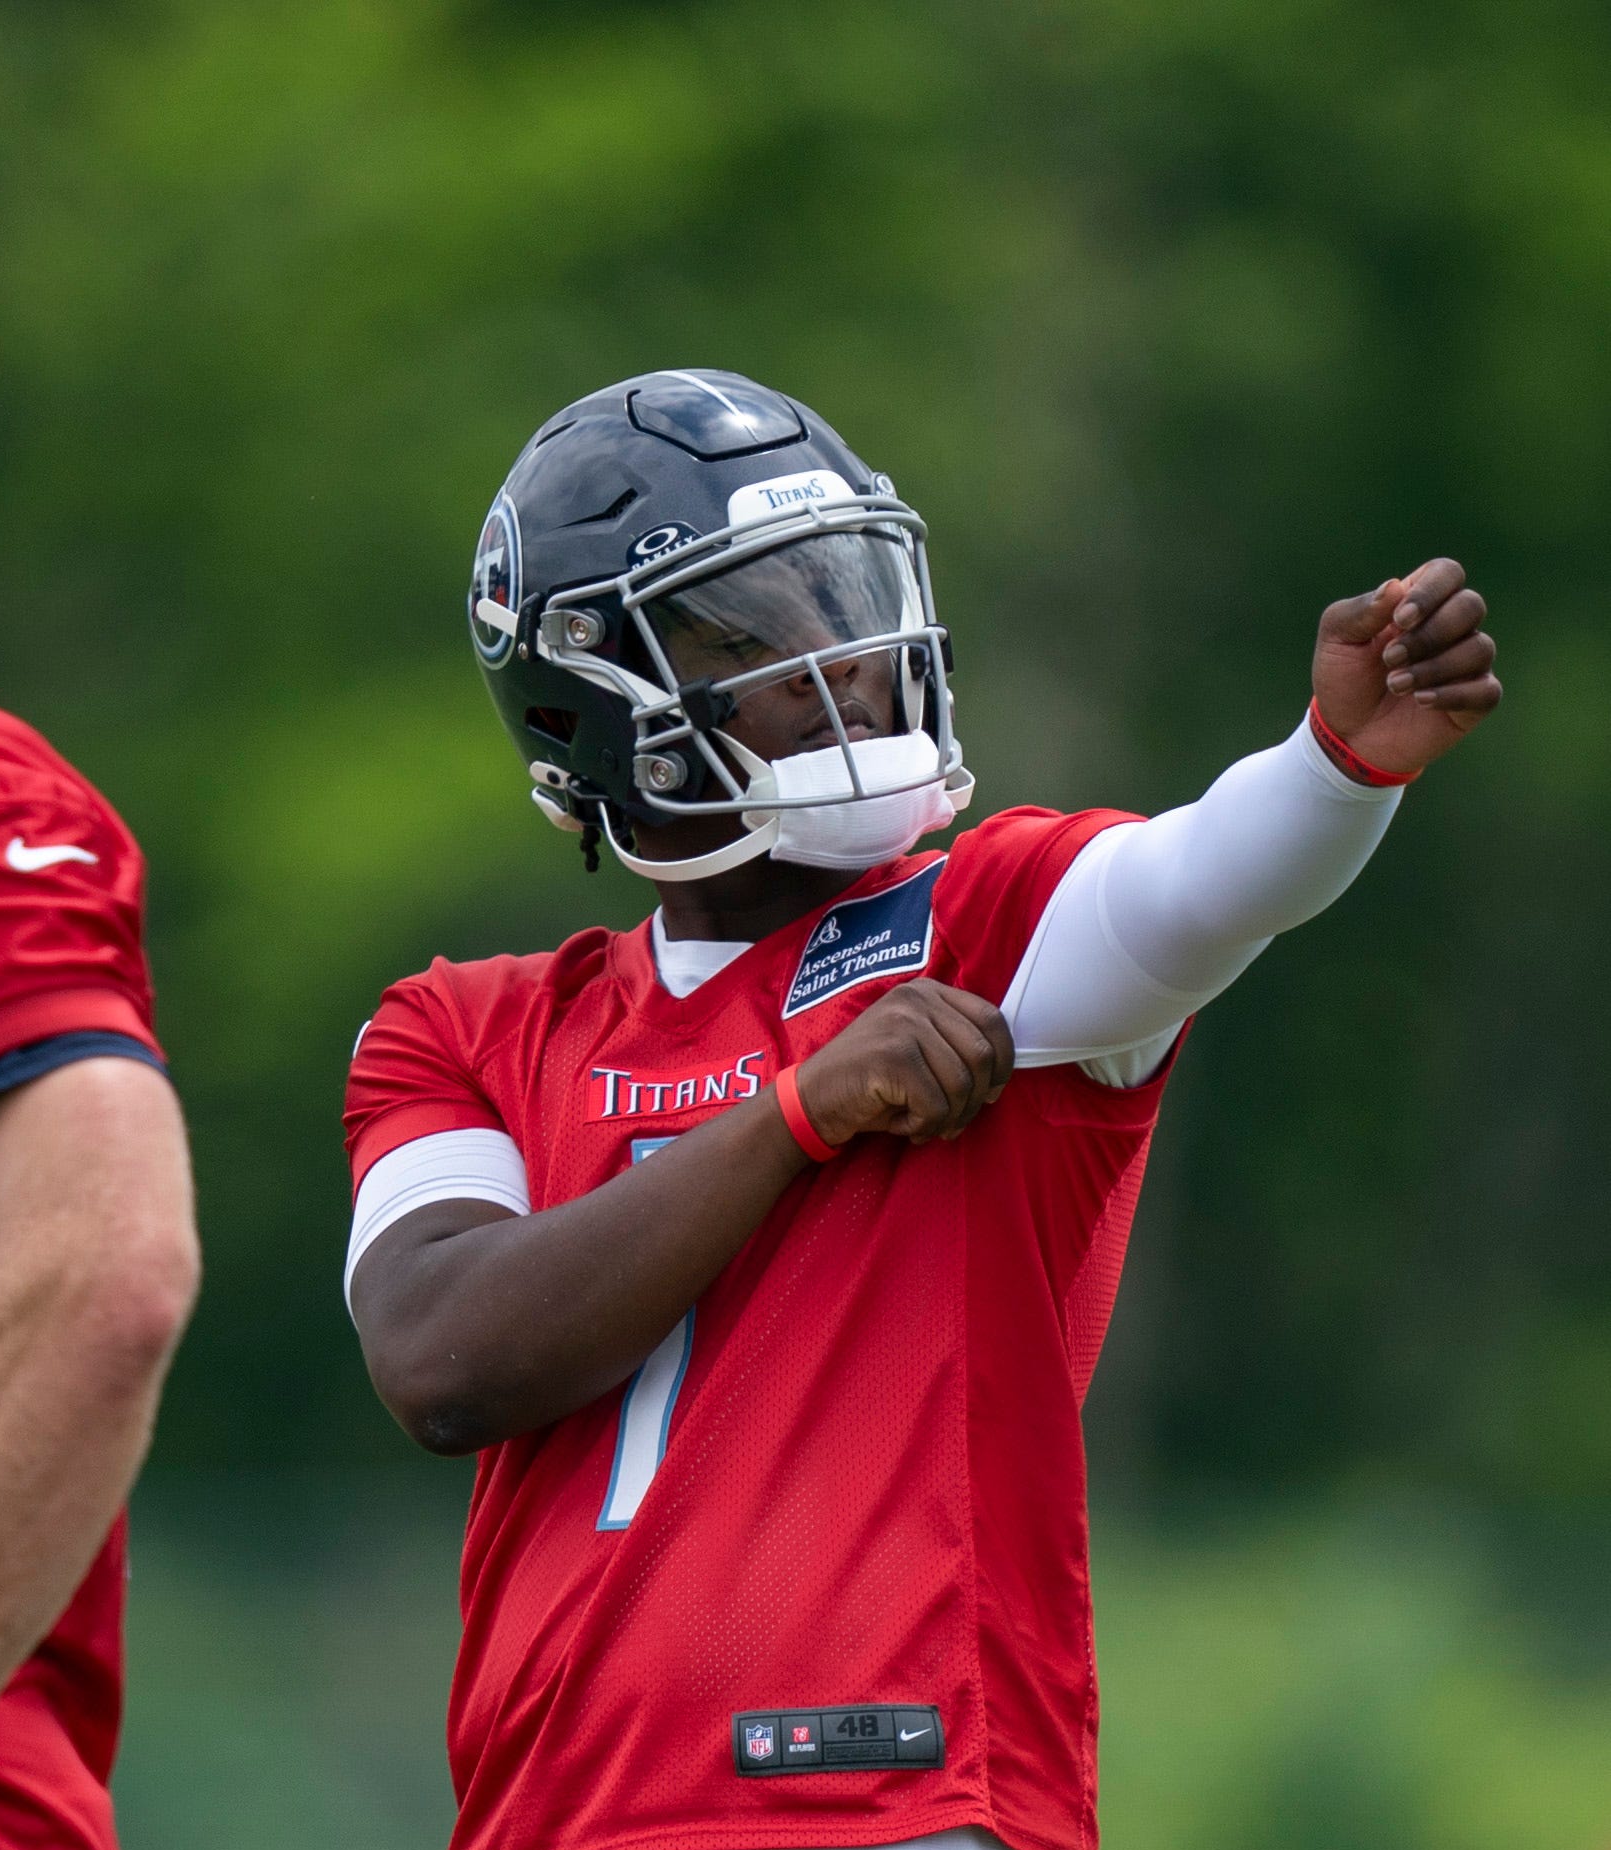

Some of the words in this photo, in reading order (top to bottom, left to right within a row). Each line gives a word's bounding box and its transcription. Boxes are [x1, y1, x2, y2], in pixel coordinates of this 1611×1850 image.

[790, 967, 839, 1003] Saint
[841, 940, 922, 977] Thomas
[797, 929, 892, 982] Ascension
[591, 1050, 766, 1118] TITANS
[837, 1714, 879, 1738] 48
